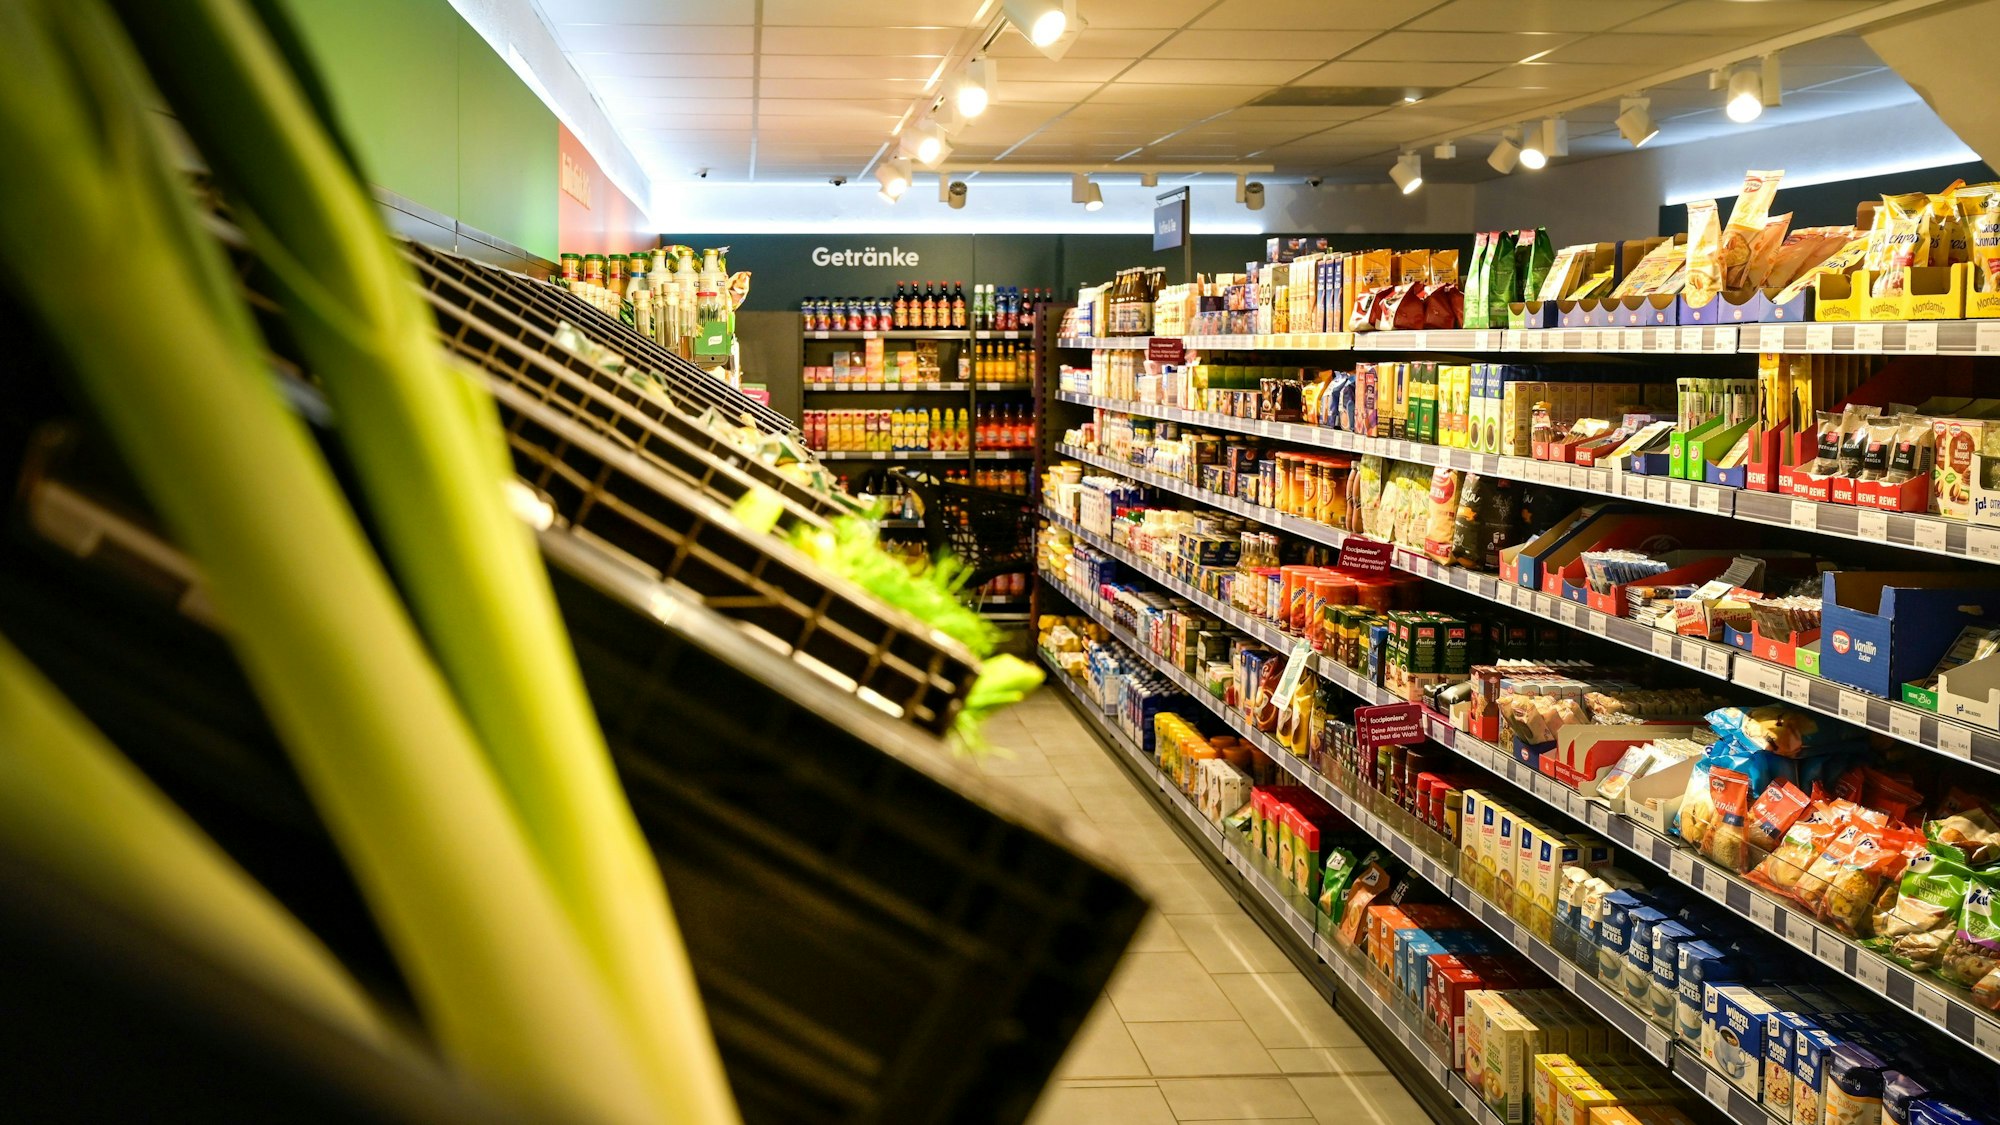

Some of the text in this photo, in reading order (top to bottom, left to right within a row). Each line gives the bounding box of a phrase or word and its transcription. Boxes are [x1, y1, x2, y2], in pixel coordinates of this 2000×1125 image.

[812, 247, 919, 267] Getränke
[1822, 302, 1851, 319] Mondamin
[1870, 301, 1900, 317] Mondamin
[1912, 300, 1946, 316] Mondamin
[1576, 451, 1591, 461] REWE
[1748, 472, 1765, 485] REWE
[1779, 475, 1793, 487] REW
[1809, 487, 1826, 498] REWE
[1834, 490, 1852, 501] REWE
[1857, 493, 1876, 504] REWE
[1879, 496, 1897, 507] REWE
[1975, 497, 1987, 516] ja!
[1358, 557, 1387, 566] Alternative?
[1854, 638, 1877, 656] Vanillin
[1917, 693, 1931, 705] Bio
[1387, 724, 1418, 733] Alternative?
[1706, 990, 1716, 1008] ja!
[1726, 1004, 1749, 1030] WÜRFEL
[1728, 1017, 1745, 1036] ZUCKER
[1769, 1017, 1778, 1034] ja!
[1769, 1039, 1787, 1059] PUDER
[1798, 1035, 1806, 1052] ja!
[1797, 1058, 1814, 1076] PUDER
